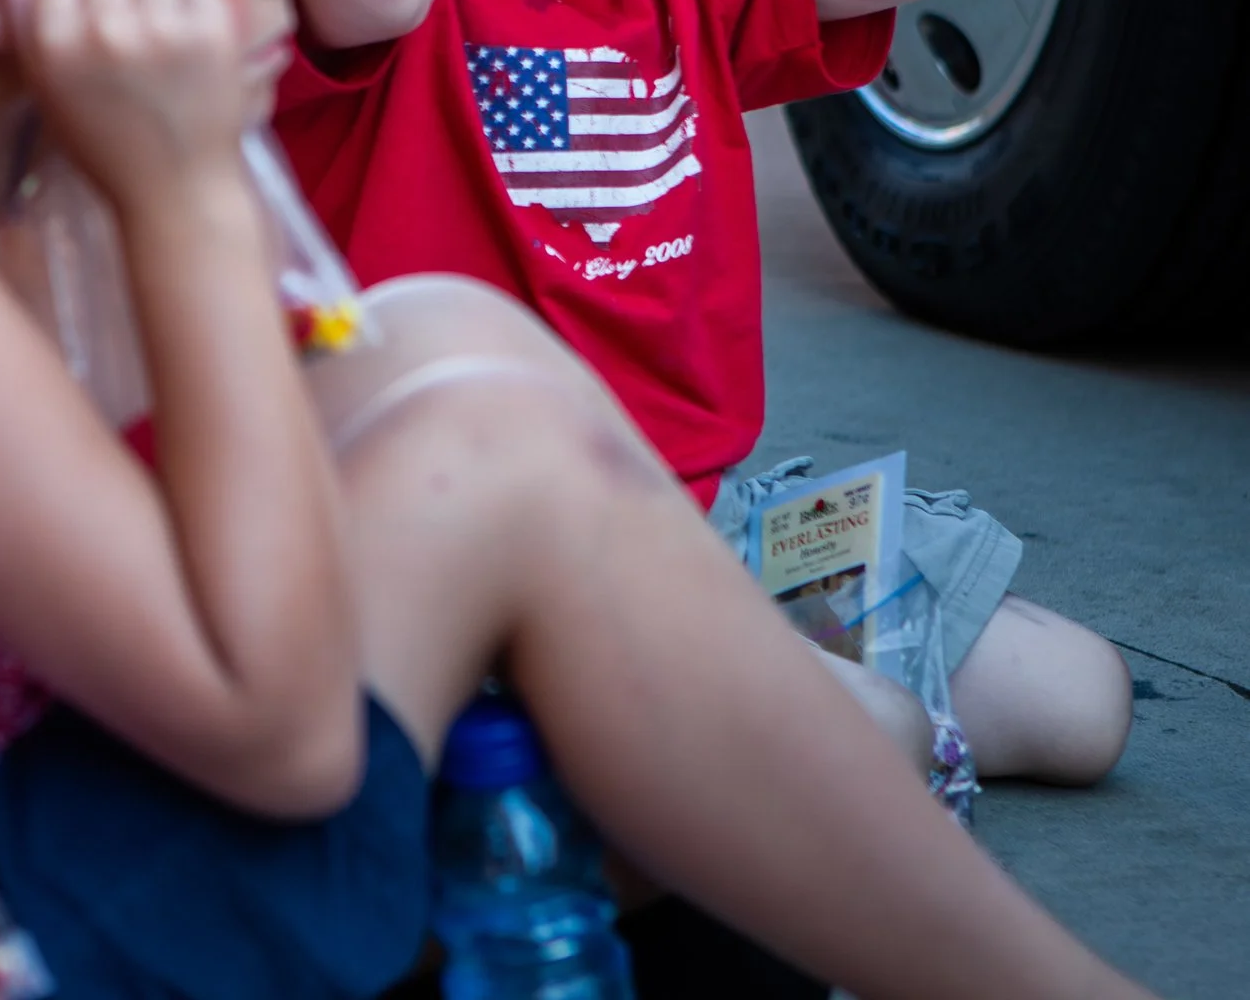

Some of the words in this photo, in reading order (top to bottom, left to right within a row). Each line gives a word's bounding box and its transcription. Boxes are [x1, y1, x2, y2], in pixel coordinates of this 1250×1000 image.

[582, 256, 638, 280] Glory
[642, 234, 694, 267] 2008
[771, 510, 869, 557] EVERLASTING
